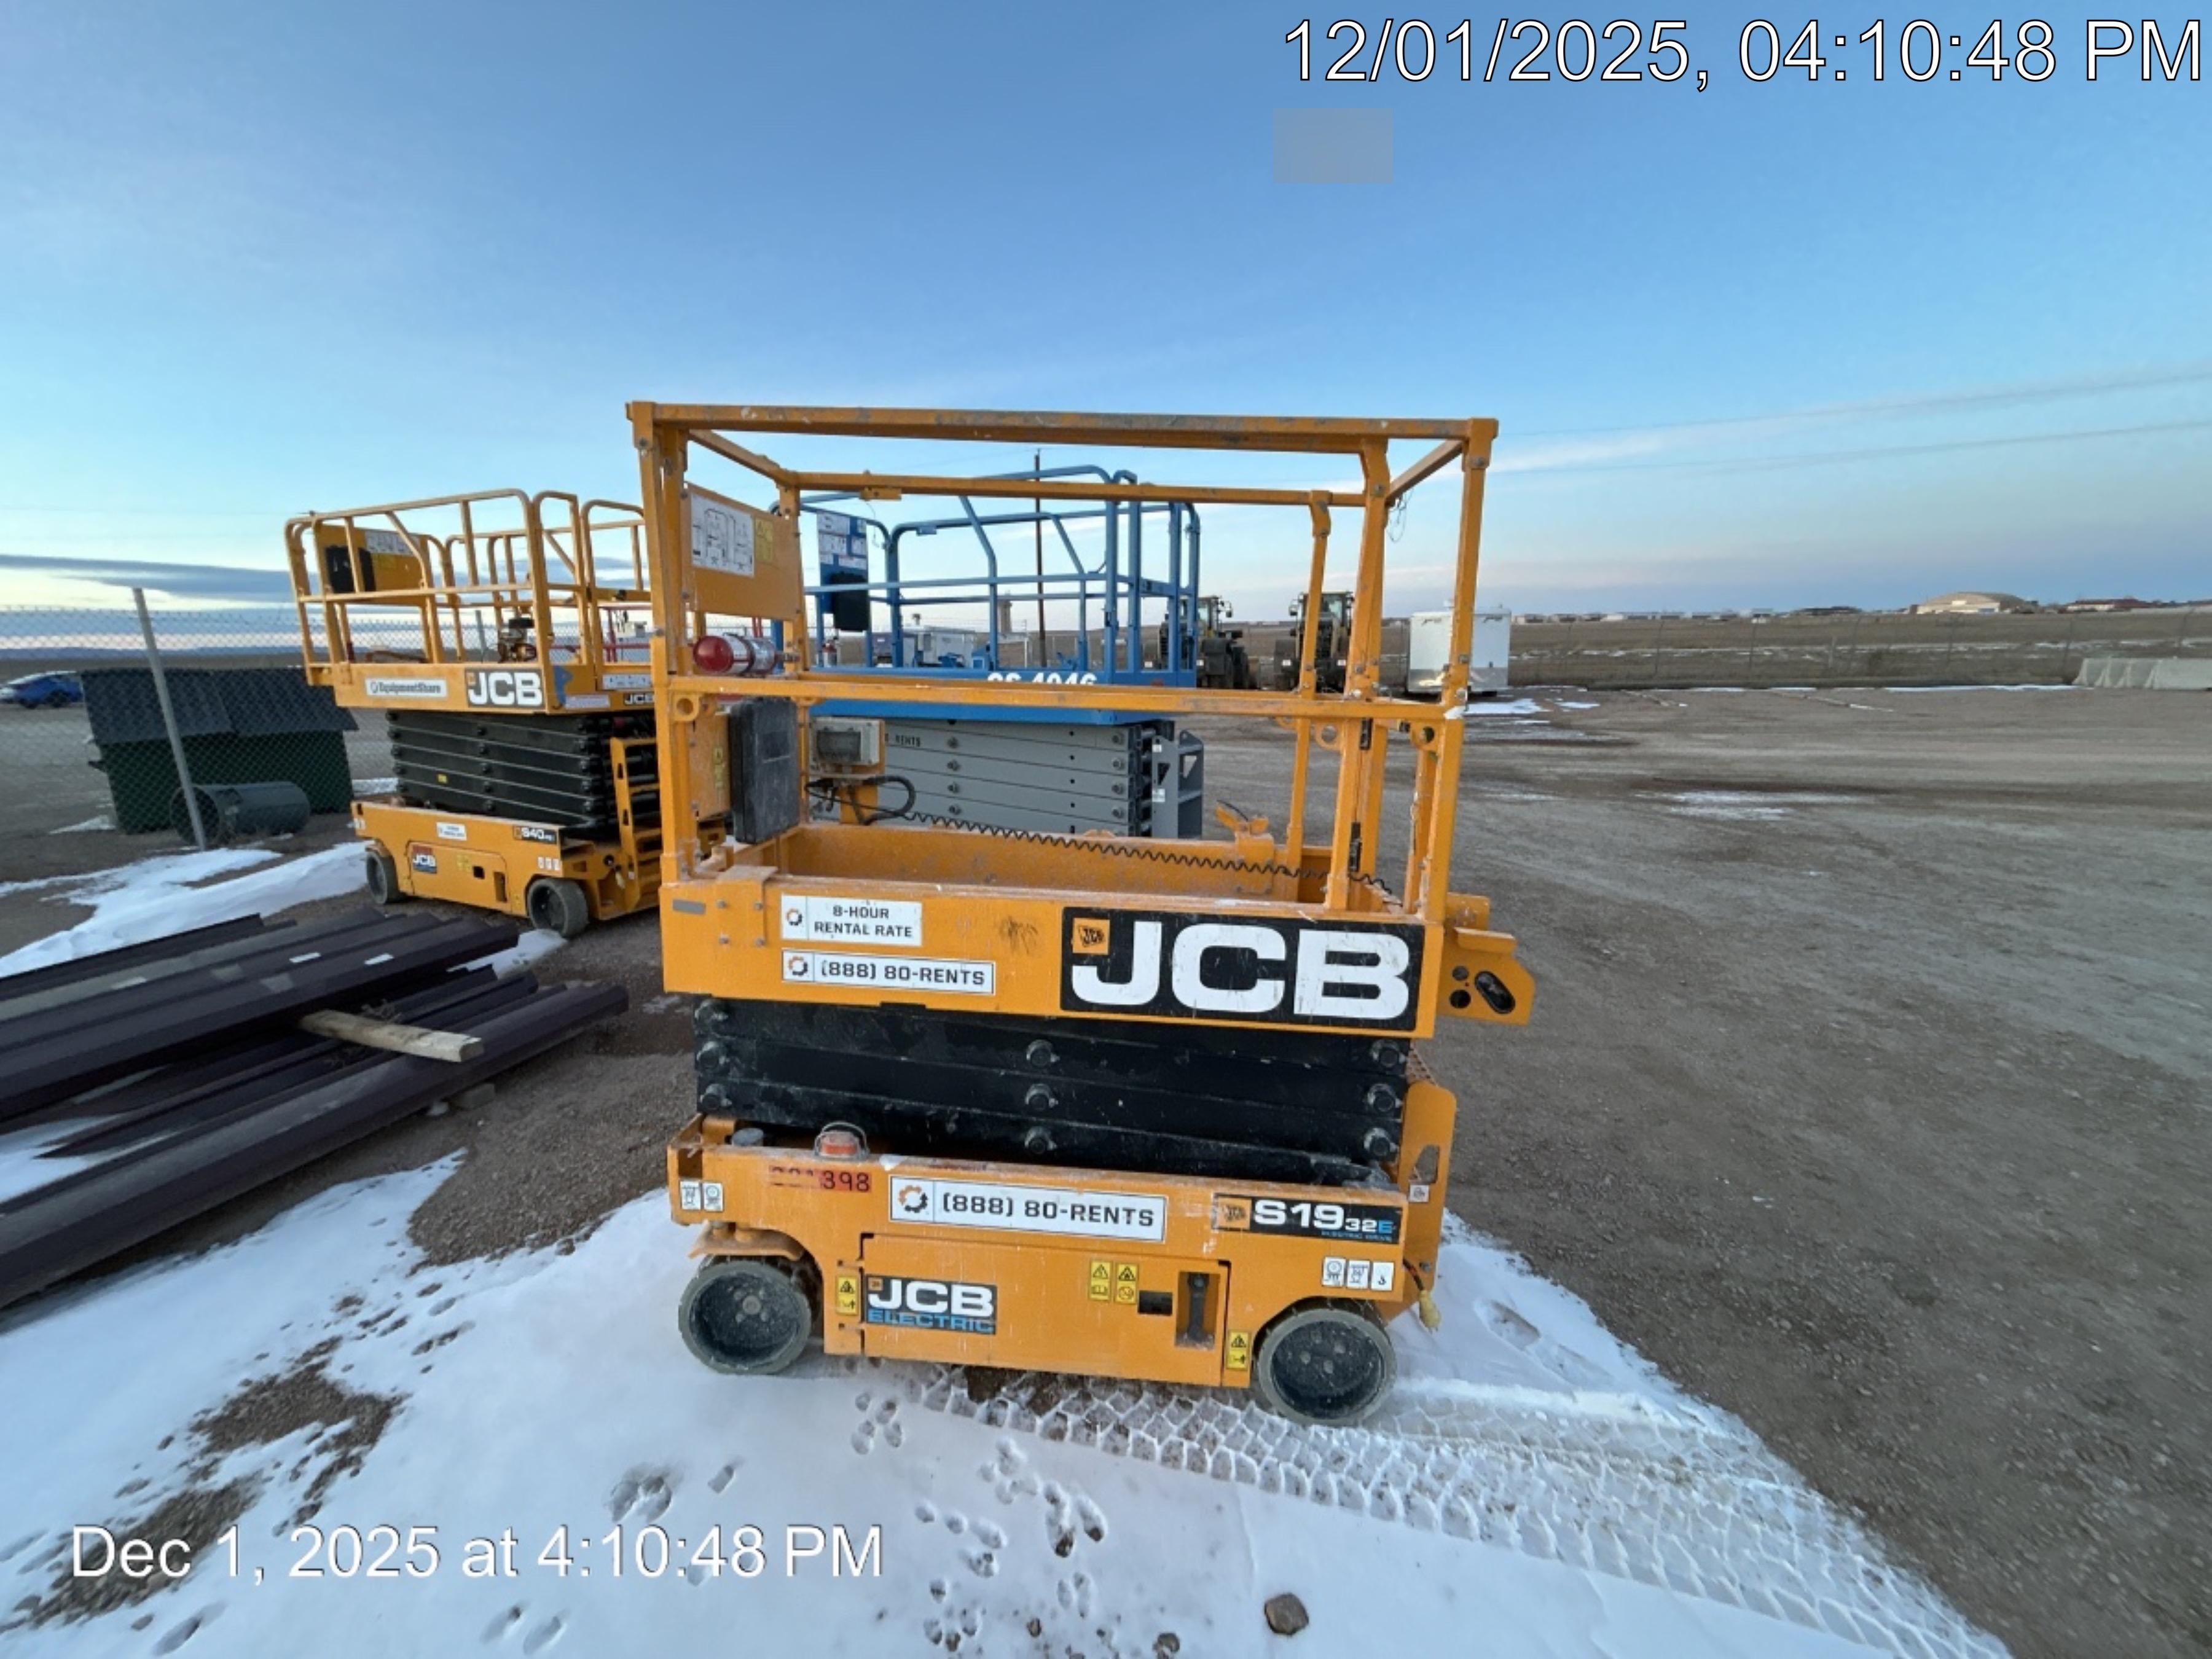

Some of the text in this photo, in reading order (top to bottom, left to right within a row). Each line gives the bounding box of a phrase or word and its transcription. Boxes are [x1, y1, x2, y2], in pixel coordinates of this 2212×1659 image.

[468, 672, 543, 706] JCB
[833, 905, 890, 919] 8-HOUR
[814, 921, 912, 938] RENTAL RATE
[822, 960, 985, 986] (888) 80-RENTS
[1071, 920, 1410, 1020] JCB
[943, 1192, 1155, 1227] (888) 80-RENTS
[868, 1279, 994, 1317] JCB
[868, 1308, 994, 1333] ELECTRIC
